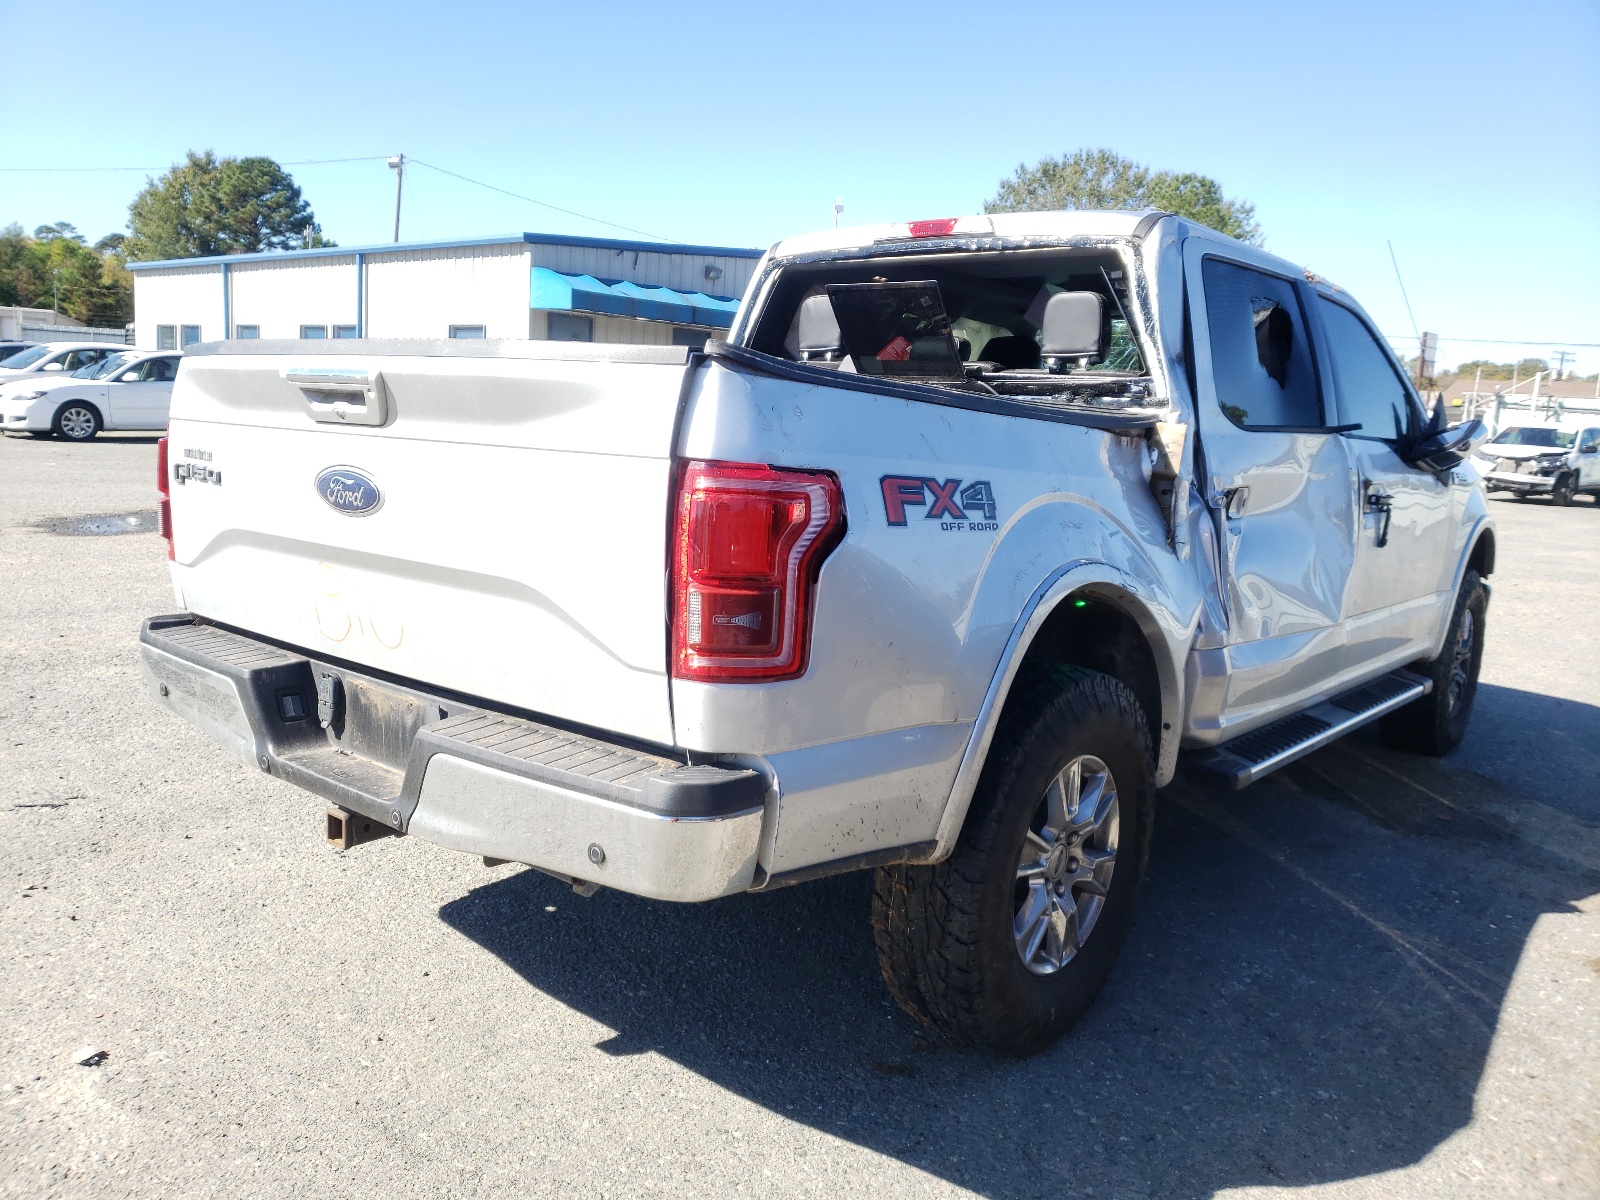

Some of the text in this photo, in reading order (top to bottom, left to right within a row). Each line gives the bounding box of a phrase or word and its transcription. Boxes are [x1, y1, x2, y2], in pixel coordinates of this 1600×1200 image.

[327, 475, 365, 507] Ford
[880, 474, 997, 527] FX4
[940, 522, 999, 531] OFF ROAD
